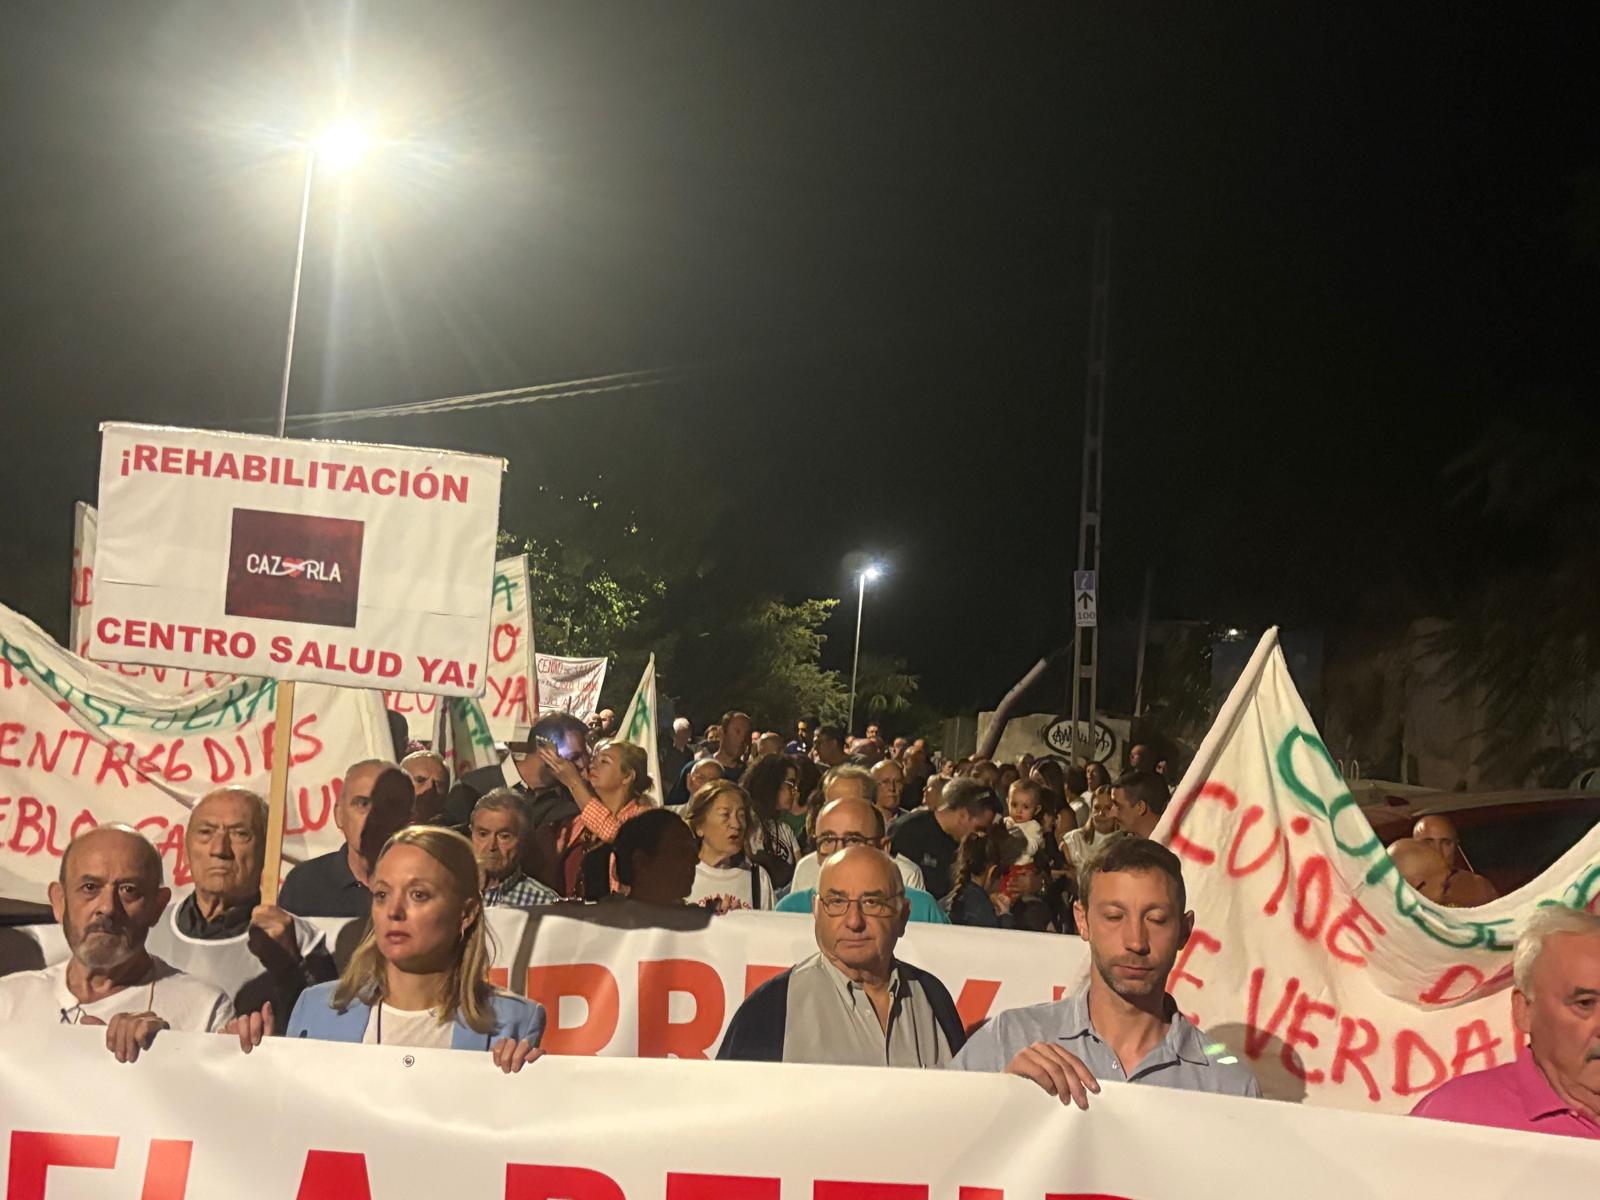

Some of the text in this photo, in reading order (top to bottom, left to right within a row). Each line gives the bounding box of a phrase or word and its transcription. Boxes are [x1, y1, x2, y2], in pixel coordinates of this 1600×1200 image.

[121, 443, 470, 503] ¡REHABILITACIÓN
[1078, 611, 1096, 620] 100
[97, 616, 257, 660] CENTRO
[269, 636, 403, 677] SALUD
[416, 656, 478, 689] YA!
